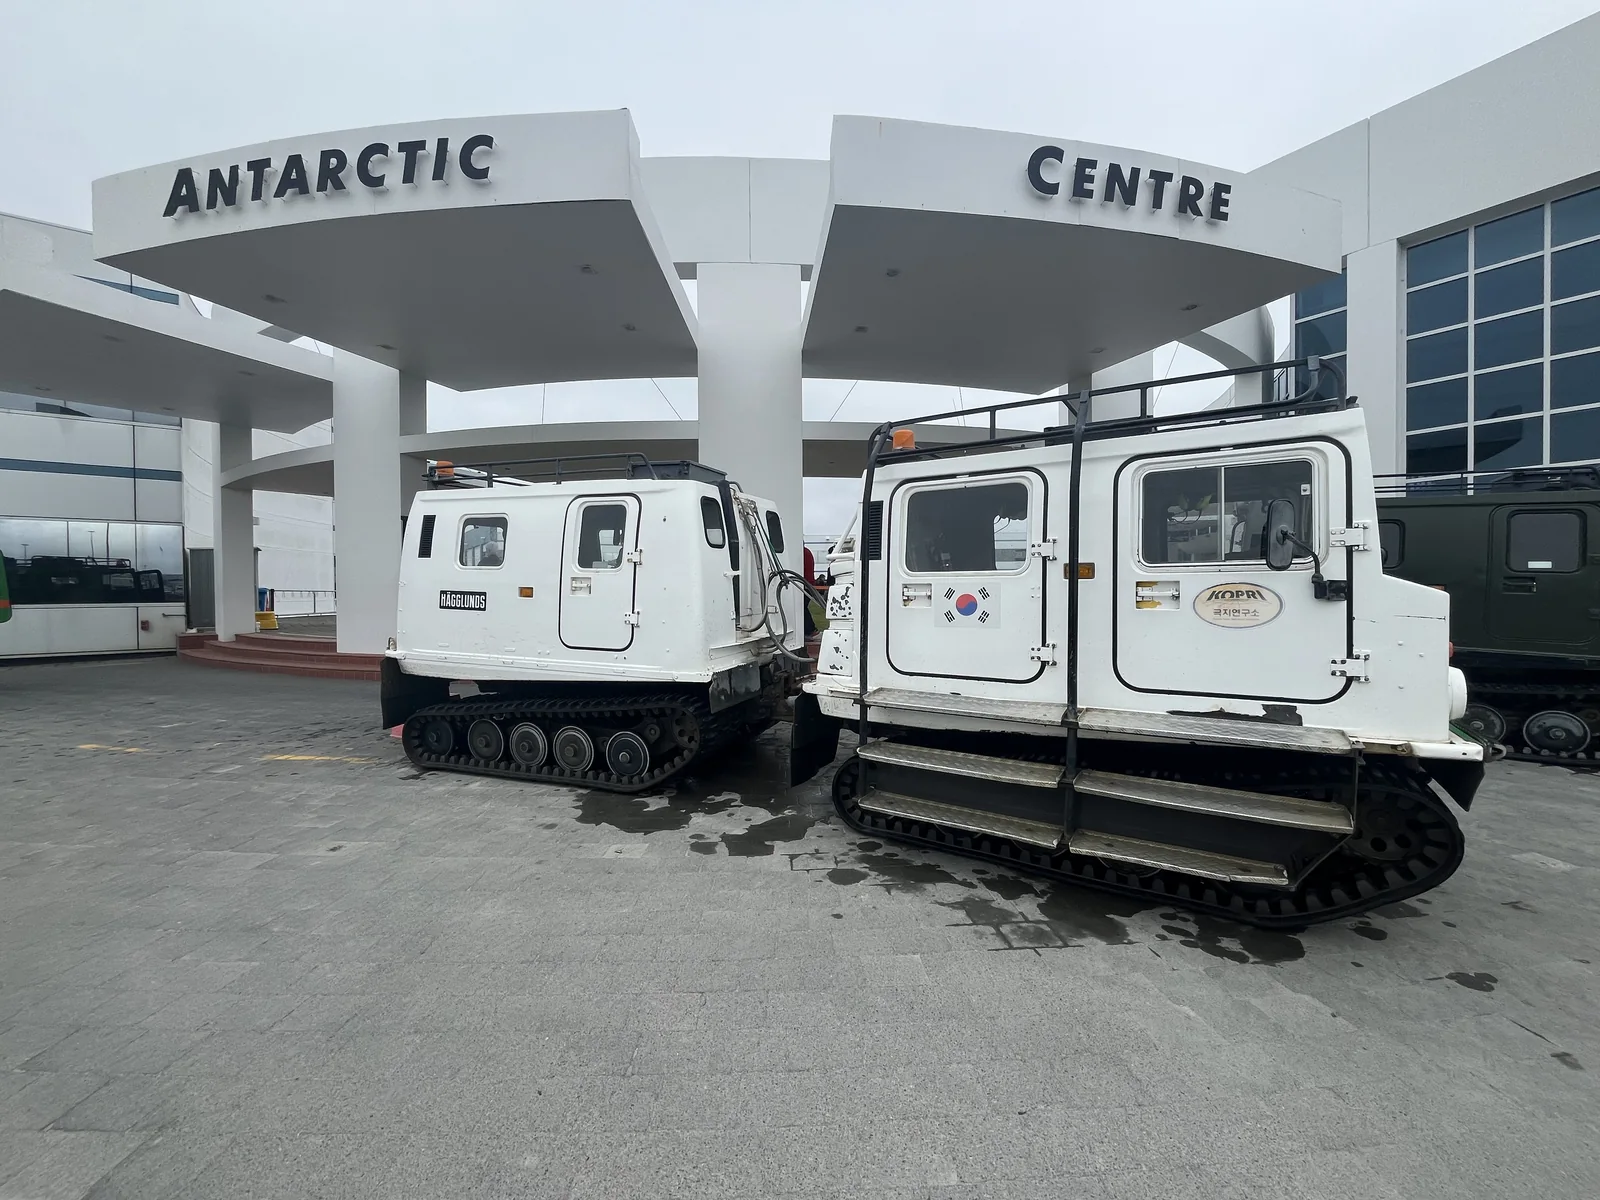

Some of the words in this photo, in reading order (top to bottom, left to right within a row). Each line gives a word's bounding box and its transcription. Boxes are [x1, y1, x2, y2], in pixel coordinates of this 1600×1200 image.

[163, 134, 494, 217] ANTARCTIC
[1027, 145, 1232, 221] CENTRE
[440, 591, 486, 609] HÄGGLUNDS
[1206, 590, 1268, 601] KOPRI
[1213, 608, 1260, 617] 극지연구소
